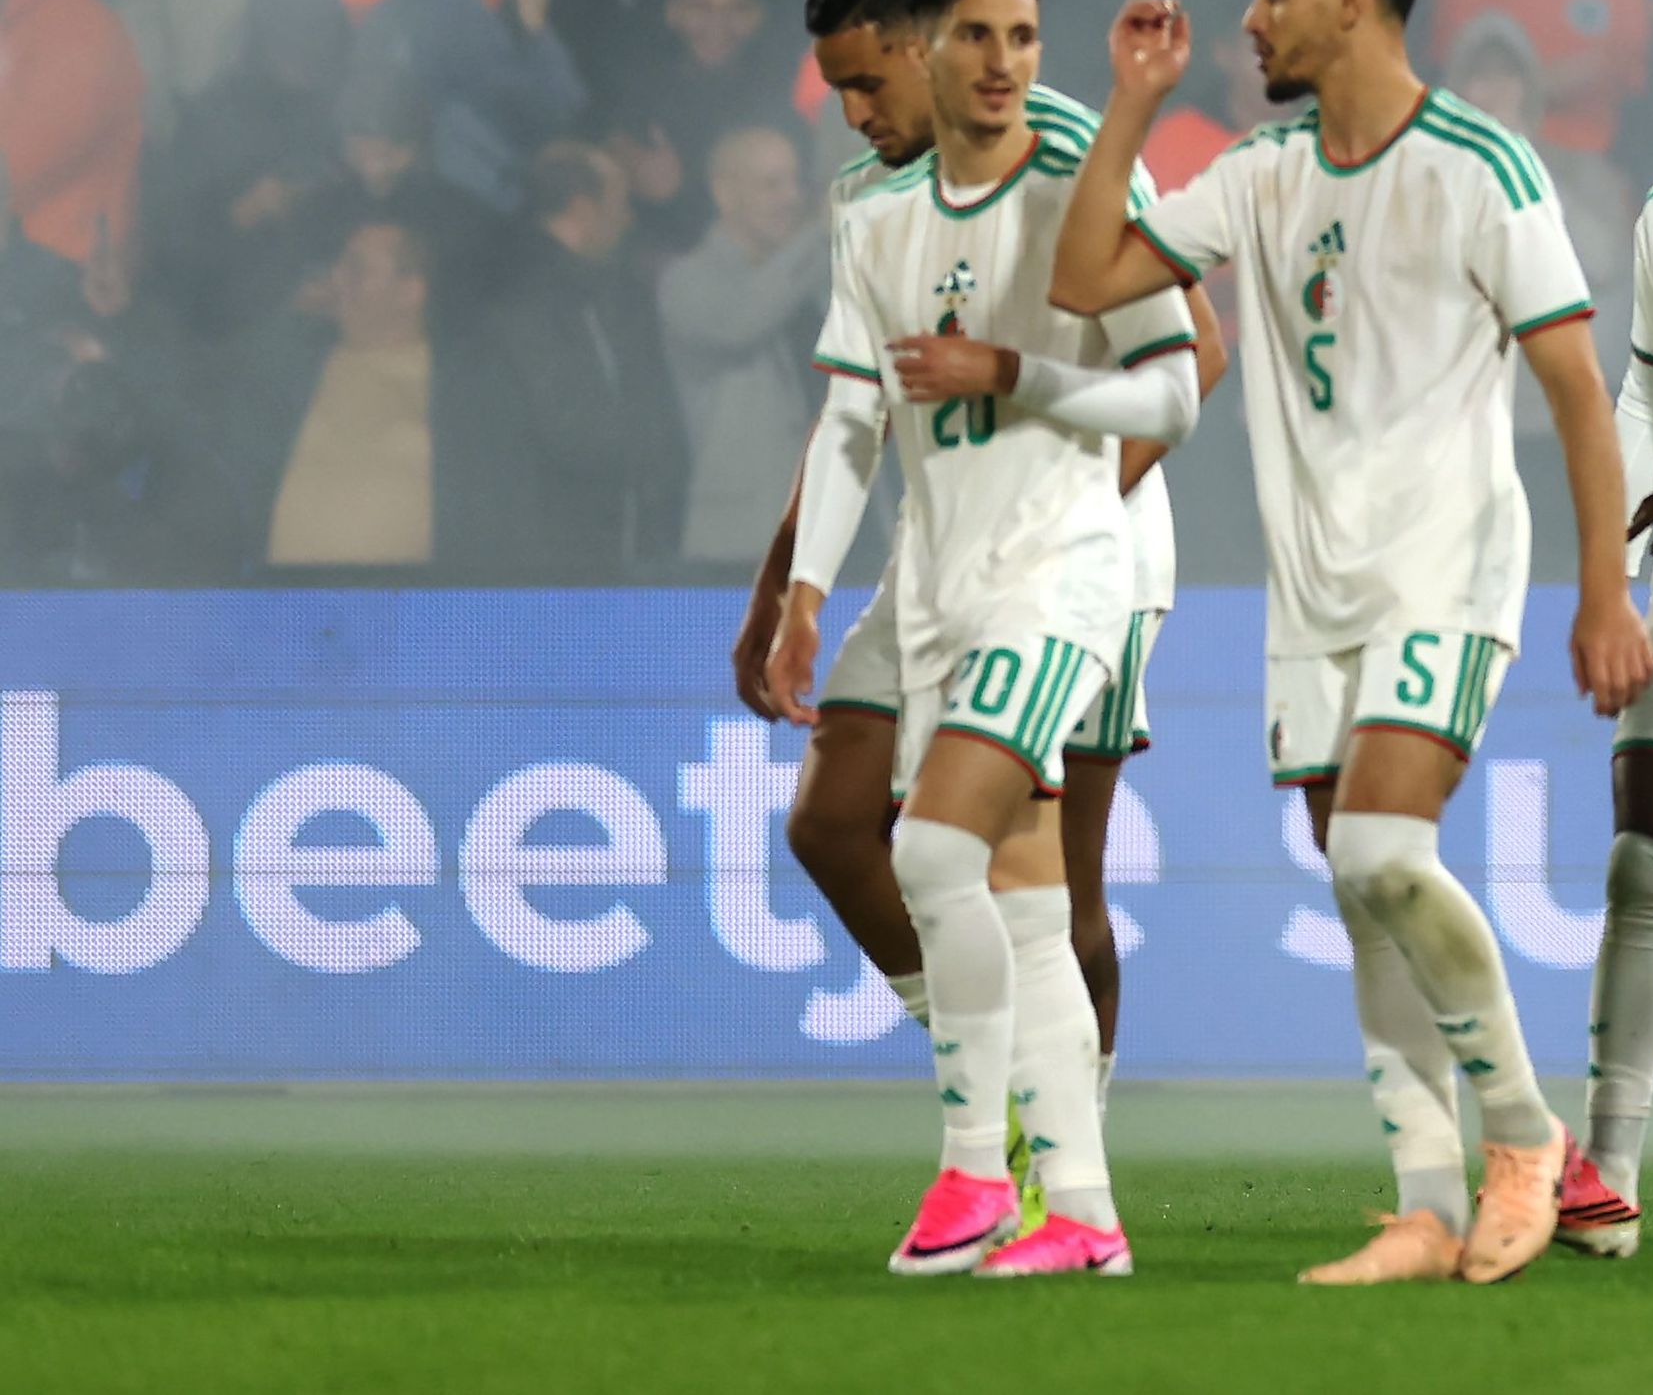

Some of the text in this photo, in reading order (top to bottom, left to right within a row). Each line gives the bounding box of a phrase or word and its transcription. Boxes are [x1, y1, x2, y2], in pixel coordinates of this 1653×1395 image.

[1304, 333, 1336, 411] 5
[1396, 631, 1441, 707] 5
[0, 690, 1161, 1045] beet
